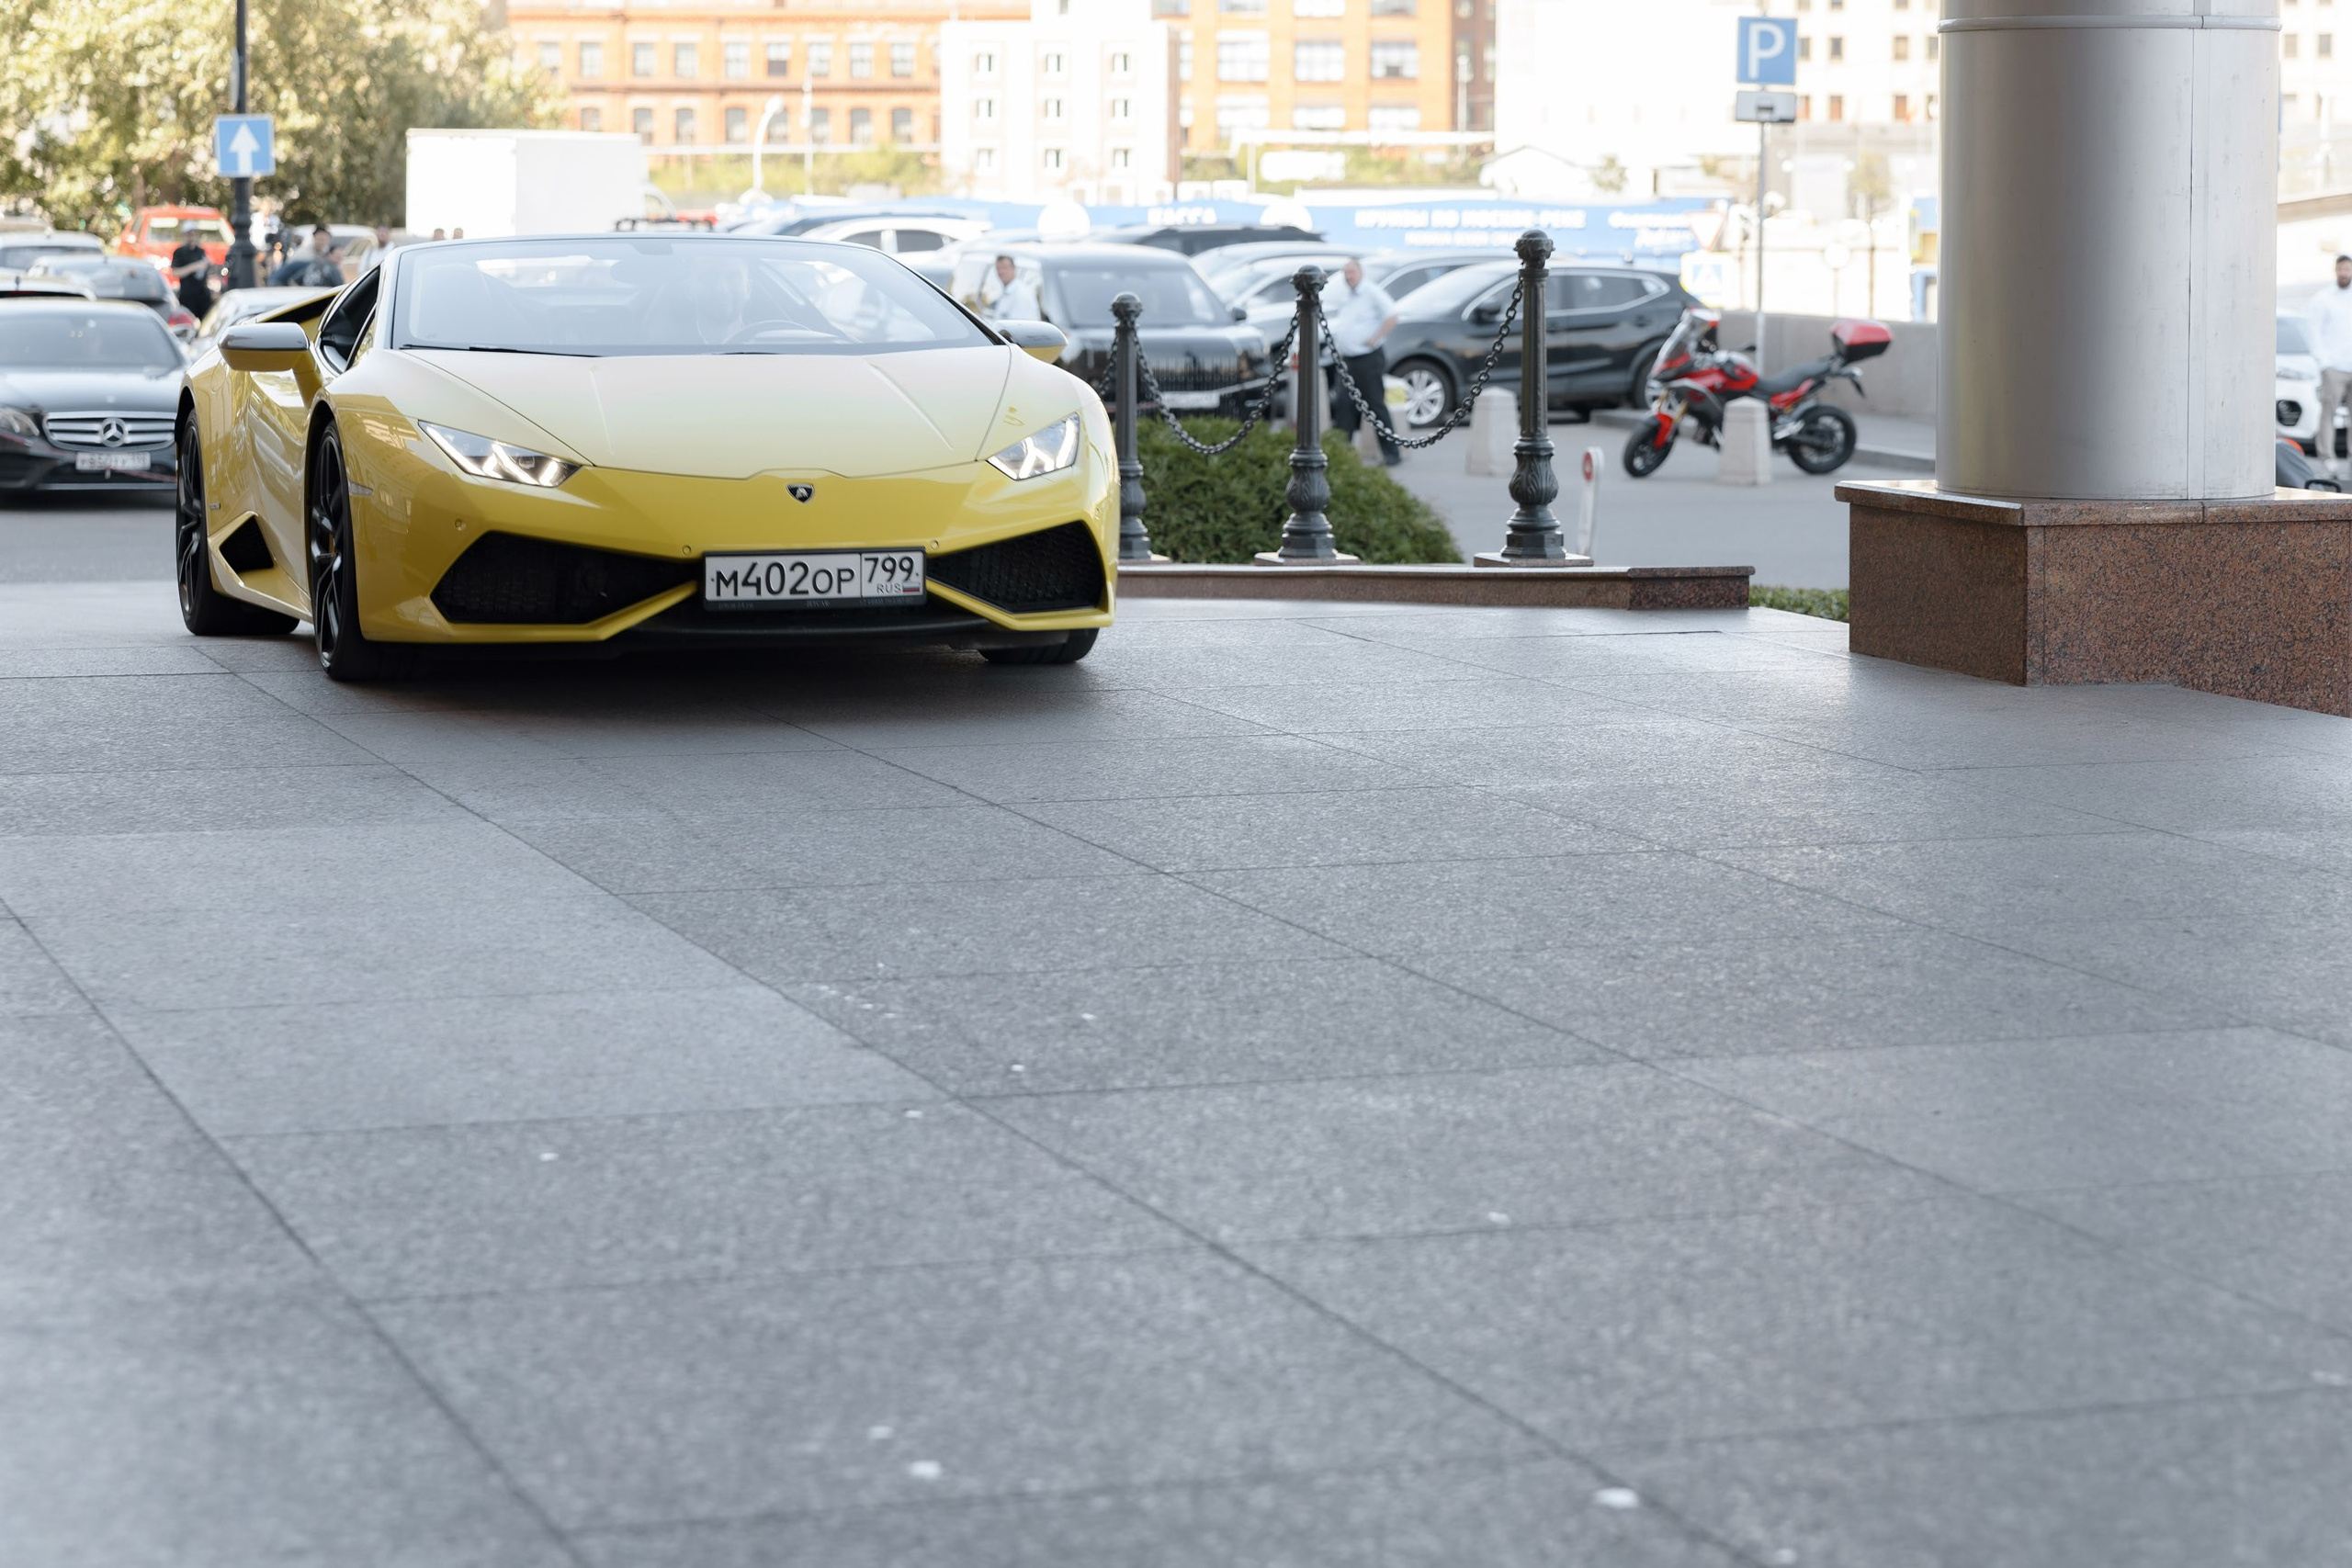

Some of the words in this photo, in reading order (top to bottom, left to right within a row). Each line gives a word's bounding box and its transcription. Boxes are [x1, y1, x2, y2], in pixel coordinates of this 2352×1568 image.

[1748, 21, 1786, 79] P
[865, 556, 914, 582] 799
[876, 582, 901, 593] RUS
